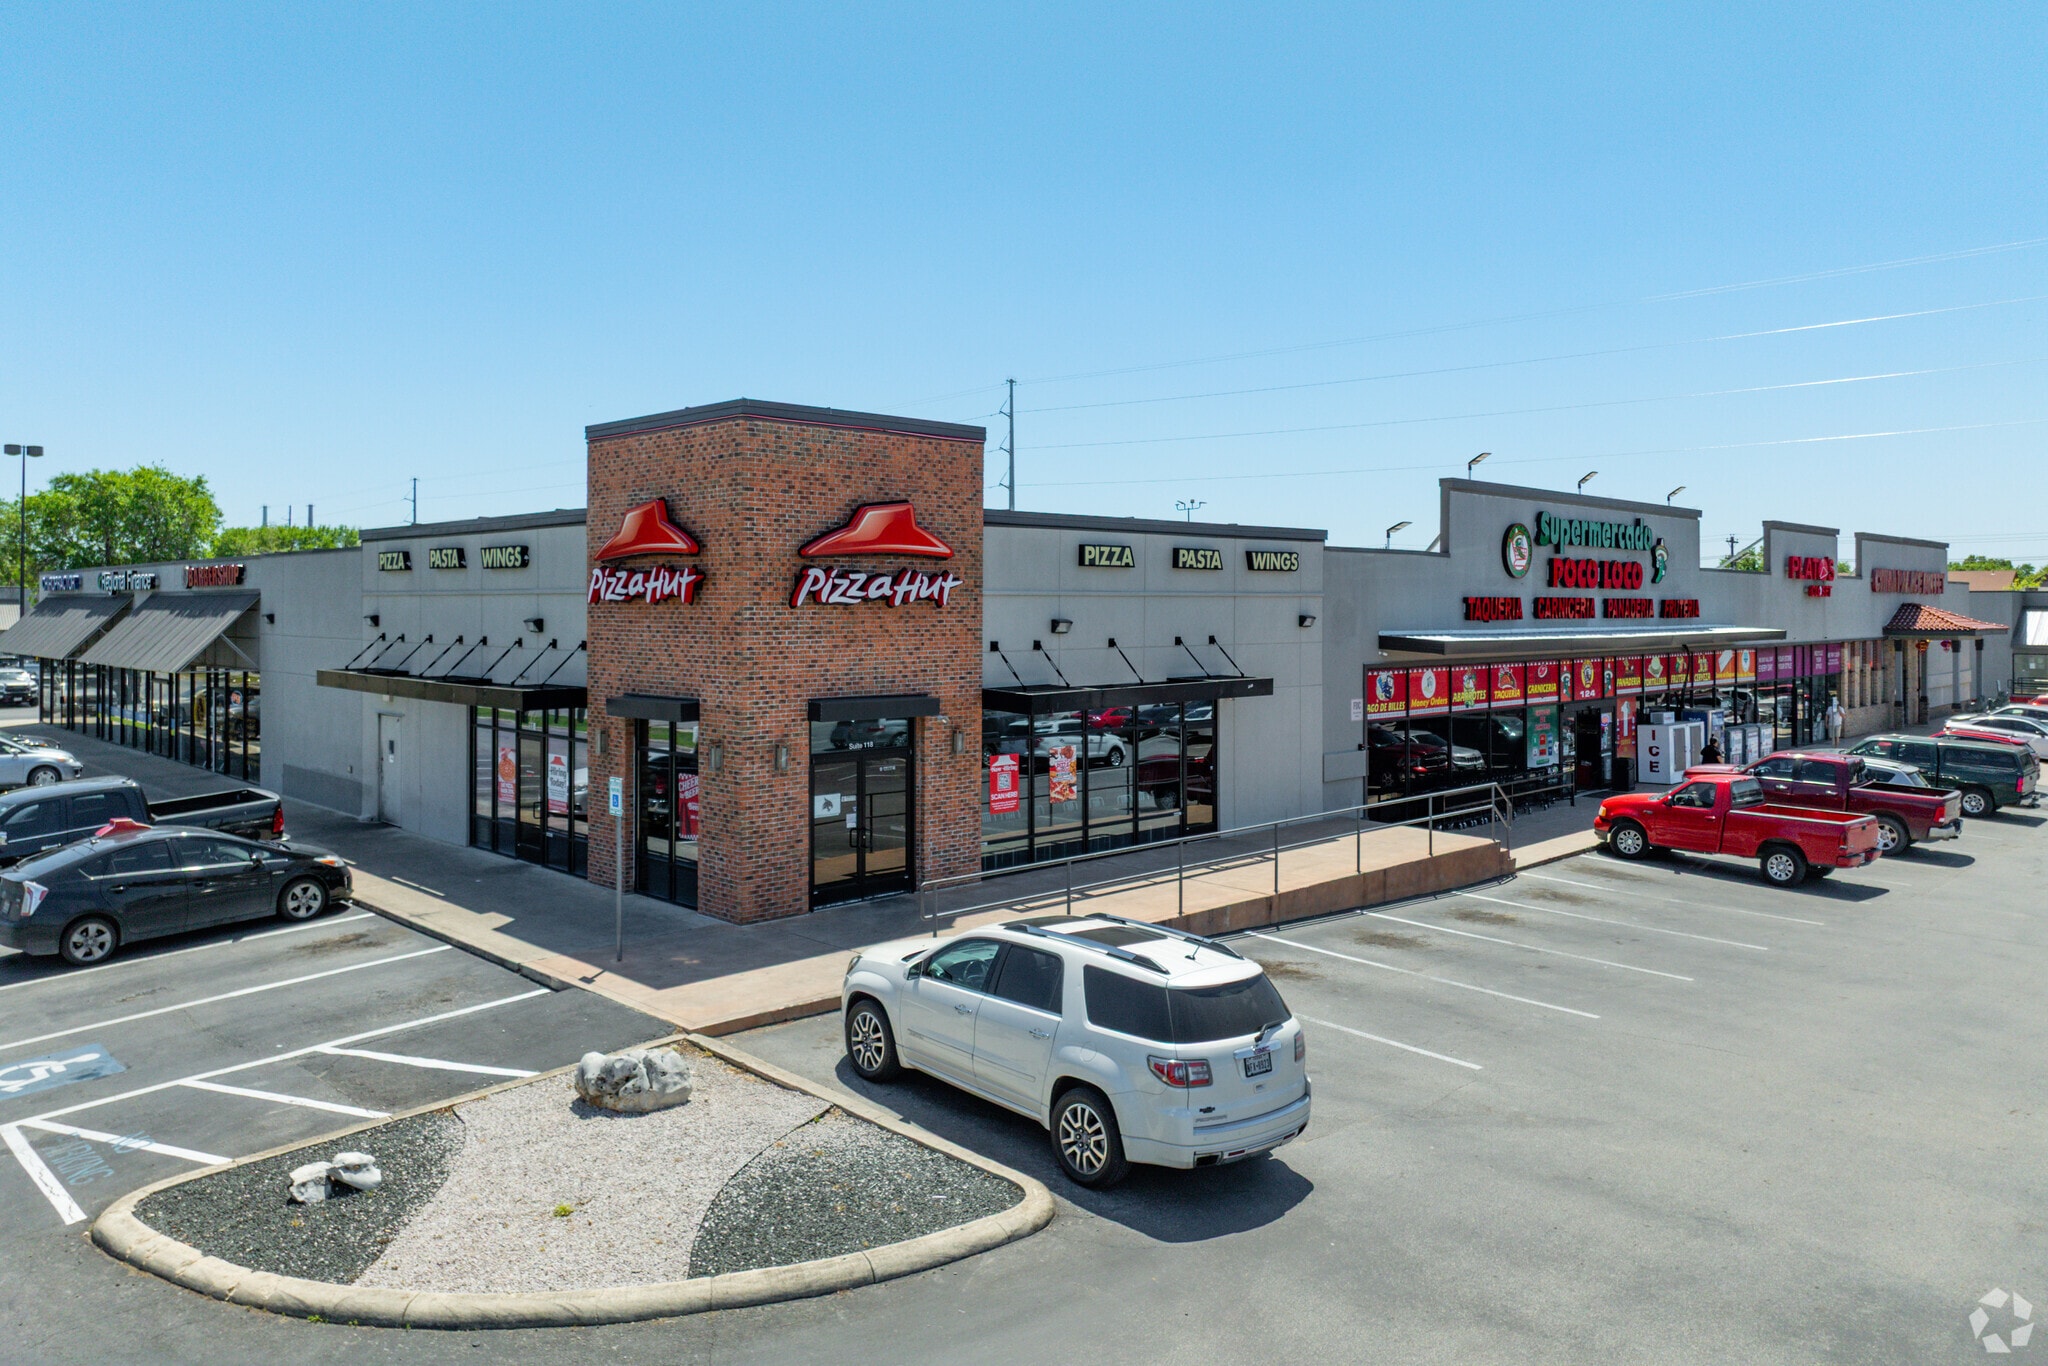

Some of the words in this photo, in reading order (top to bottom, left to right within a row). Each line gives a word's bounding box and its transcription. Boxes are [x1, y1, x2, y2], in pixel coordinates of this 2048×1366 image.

[1535, 510, 1653, 554] Supermercado
[379, 552, 405, 570] PIZZA
[429, 548, 459, 568] PASTA
[481, 546, 521, 568] WINGS
[1084, 545, 1134, 566] PIZZA
[1178, 549, 1222, 569] PASTA
[1252, 552, 1299, 571] WINGS
[101, 571, 126, 596] Regional
[127, 569, 151, 591] Finance
[187, 564, 240, 588] BARBERSHOP
[1550, 557, 1599, 589] POCO
[1601, 559, 1643, 590] LOCO
[588, 567, 645, 603] Pizza
[645, 566, 699, 603] Hut
[797, 568, 893, 607] Pizza
[891, 569, 964, 606] Hut
[1466, 597, 1523, 622] TAQUERIA
[1535, 597, 1596, 619] CARNICERIA
[1606, 598, 1654, 619] PANADERIA
[1662, 599, 1700, 619] FRUTERIA
[1528, 683, 1557, 695] CARNICERIA
[1616, 677, 1641, 687] PANADERIA
[1411, 698, 1430, 708] Money
[1430, 696, 1448, 706] Orders
[1494, 689, 1521, 699] TAQUERIA
[1580, 690, 1596, 698] 124
[1380, 702, 1387, 712] DE
[849, 742, 863, 750] Suite
[1649, 729, 1660, 773] ICE
[550, 766, 567, 780] Hiring
[991, 793, 1007, 801] SCAN
